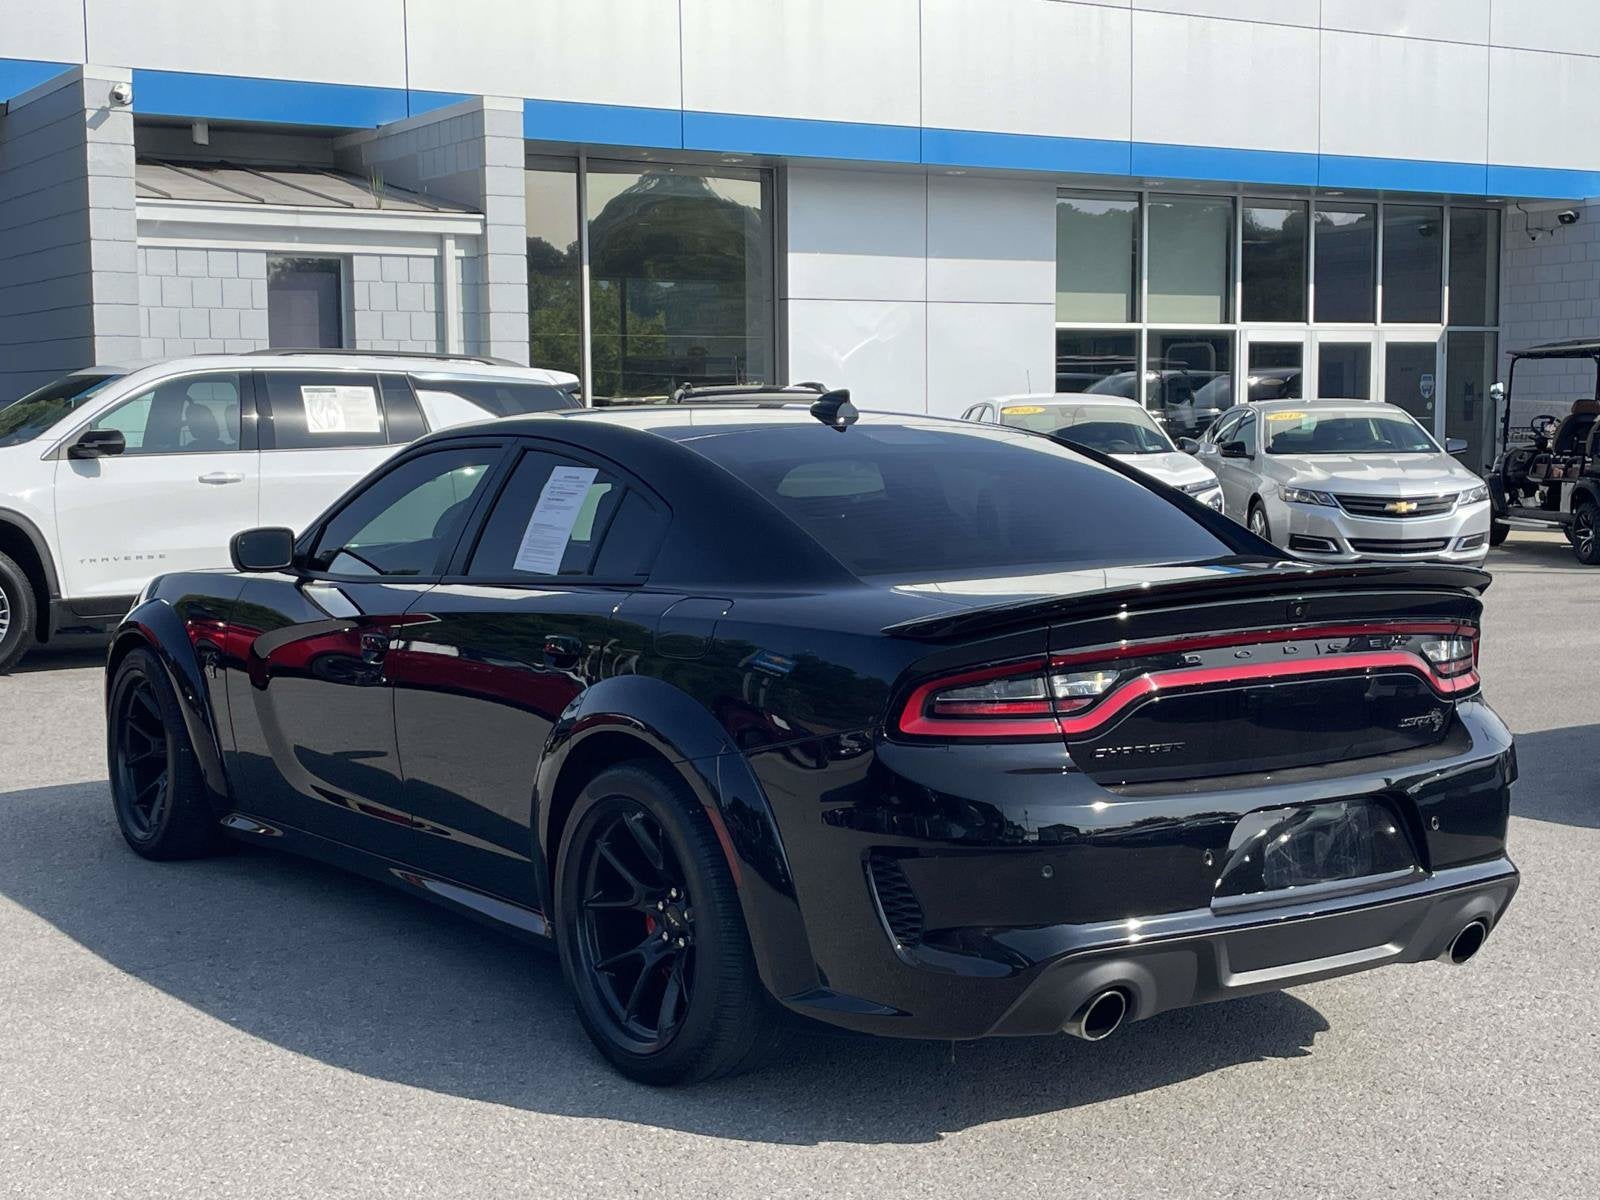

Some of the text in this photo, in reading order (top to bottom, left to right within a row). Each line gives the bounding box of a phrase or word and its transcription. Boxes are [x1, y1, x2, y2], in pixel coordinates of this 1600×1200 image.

[79, 553, 166, 564] TRAVERSE
[1184, 637, 1384, 666] DODGE
[1094, 742, 1186, 758] CHARGER
